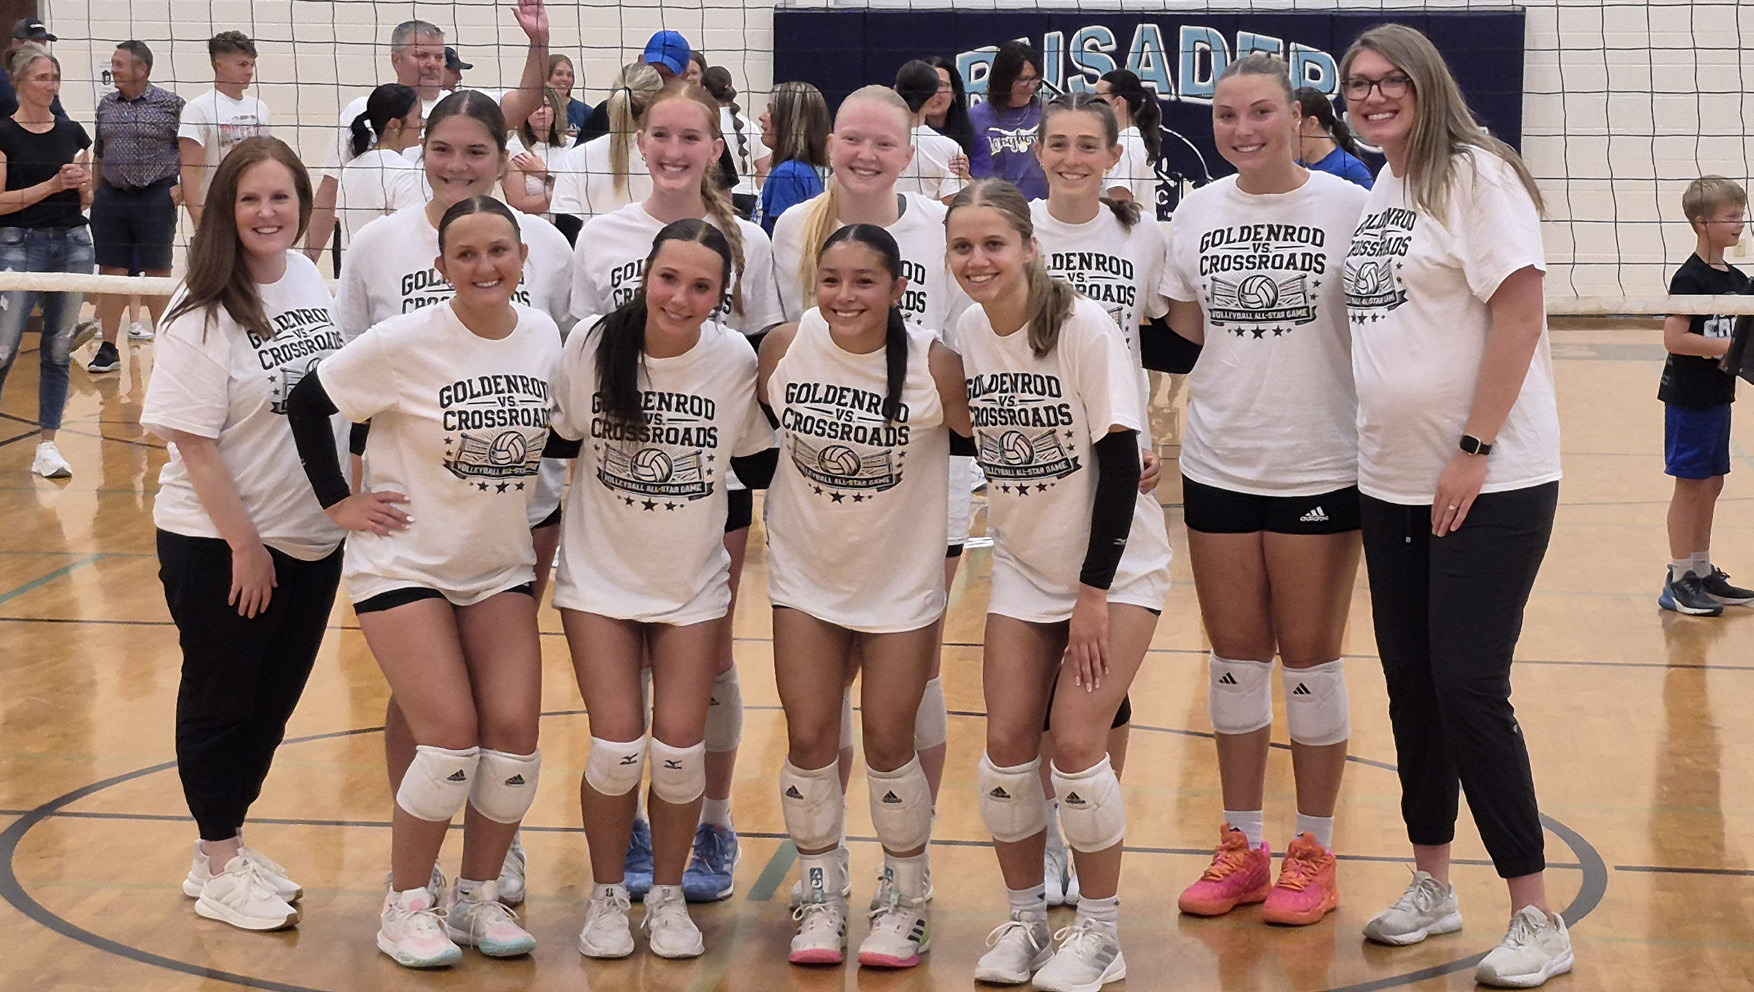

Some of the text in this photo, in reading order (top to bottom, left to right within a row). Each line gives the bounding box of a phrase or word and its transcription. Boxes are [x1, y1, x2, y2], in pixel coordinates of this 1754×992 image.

[1199, 223, 1325, 254] GOLDENROD
[1047, 252, 1134, 280] DENROD
[1199, 252, 1327, 276] CROSSROADS
[966, 373, 1062, 400] GOLDENROD
[443, 407, 551, 431] CROSSROA
[591, 391, 715, 421] GENROD
[591, 417, 718, 449] CROSSROADS
[782, 407, 910, 447] CROSSROADS
